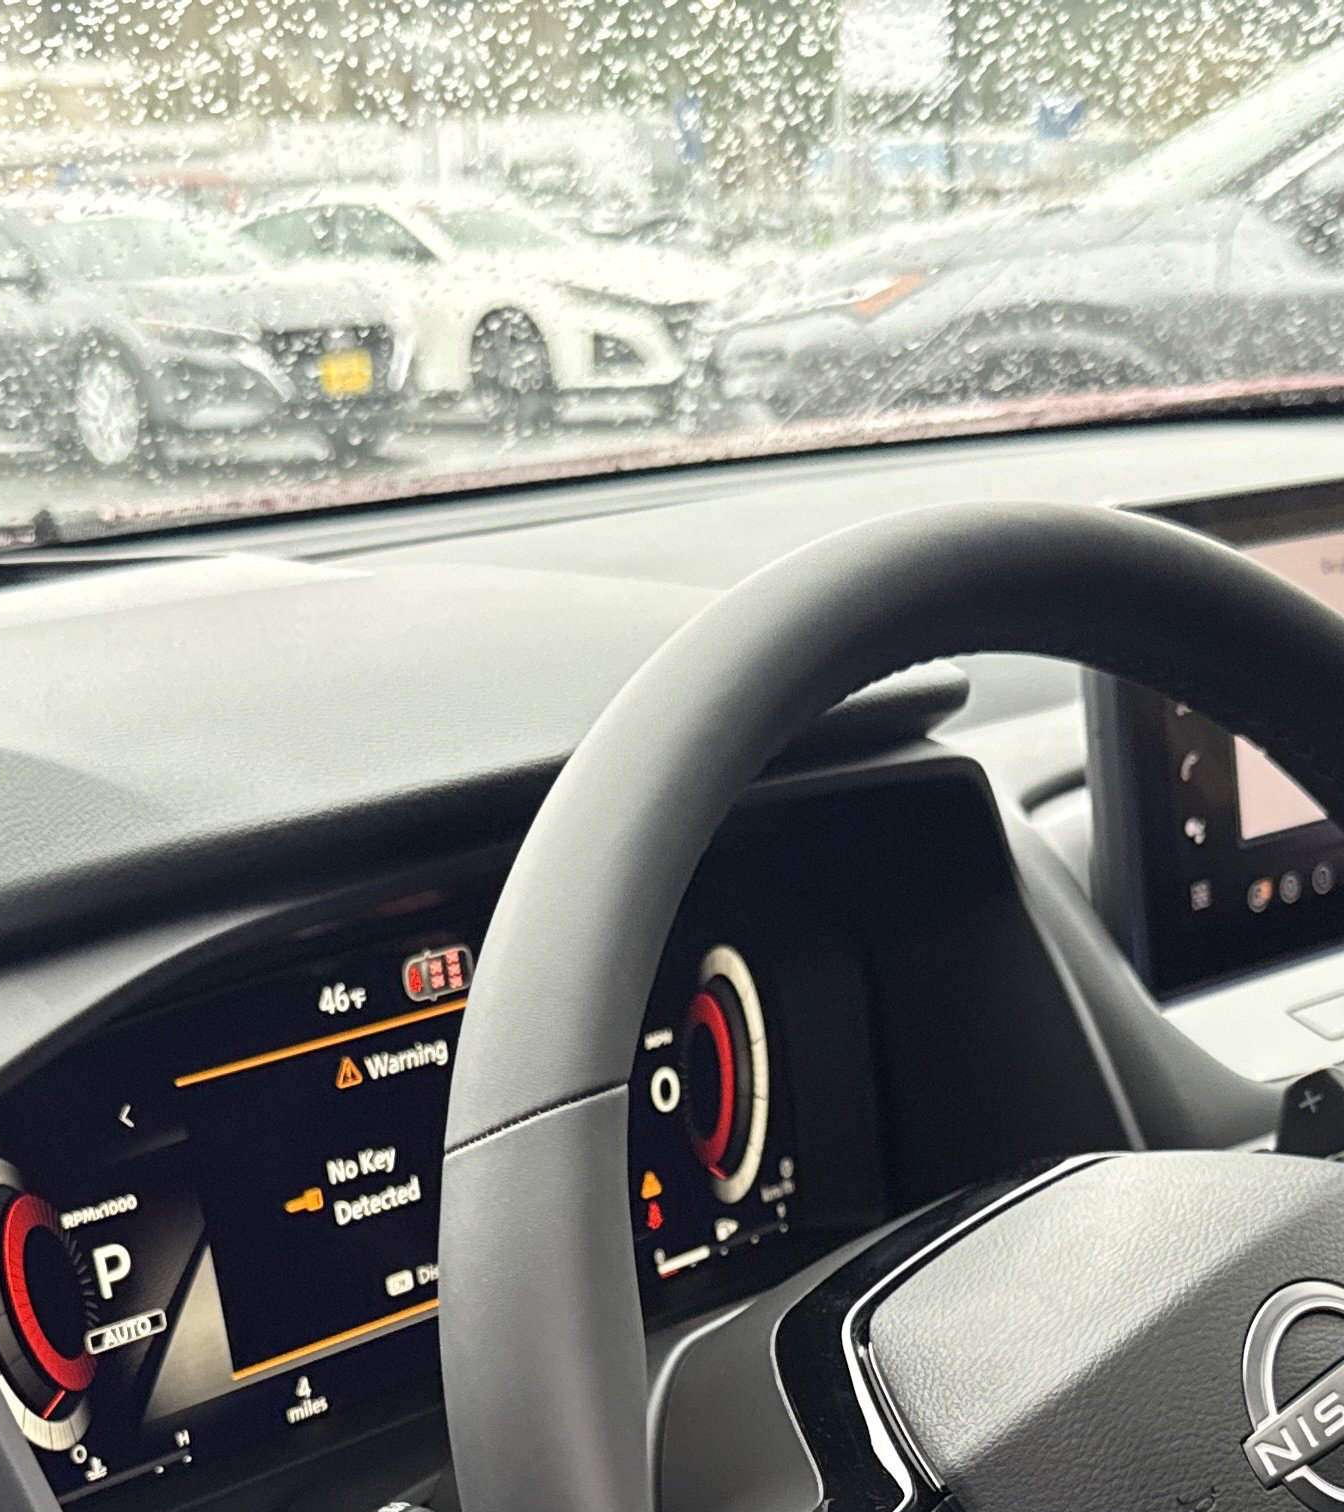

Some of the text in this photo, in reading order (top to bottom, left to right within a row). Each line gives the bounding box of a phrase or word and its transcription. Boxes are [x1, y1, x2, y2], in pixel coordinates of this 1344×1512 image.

[364, 1039, 449, 1080] Warning
[326, 1146, 396, 1185] No Key
[60, 1193, 138, 1230] RPMx1000
[333, 1174, 421, 1226] Detected
[92, 1243, 132, 1299] P
[104, 1315, 152, 1348] AUTO
[295, 1375, 312, 1399] 4
[286, 1396, 329, 1424] miles
